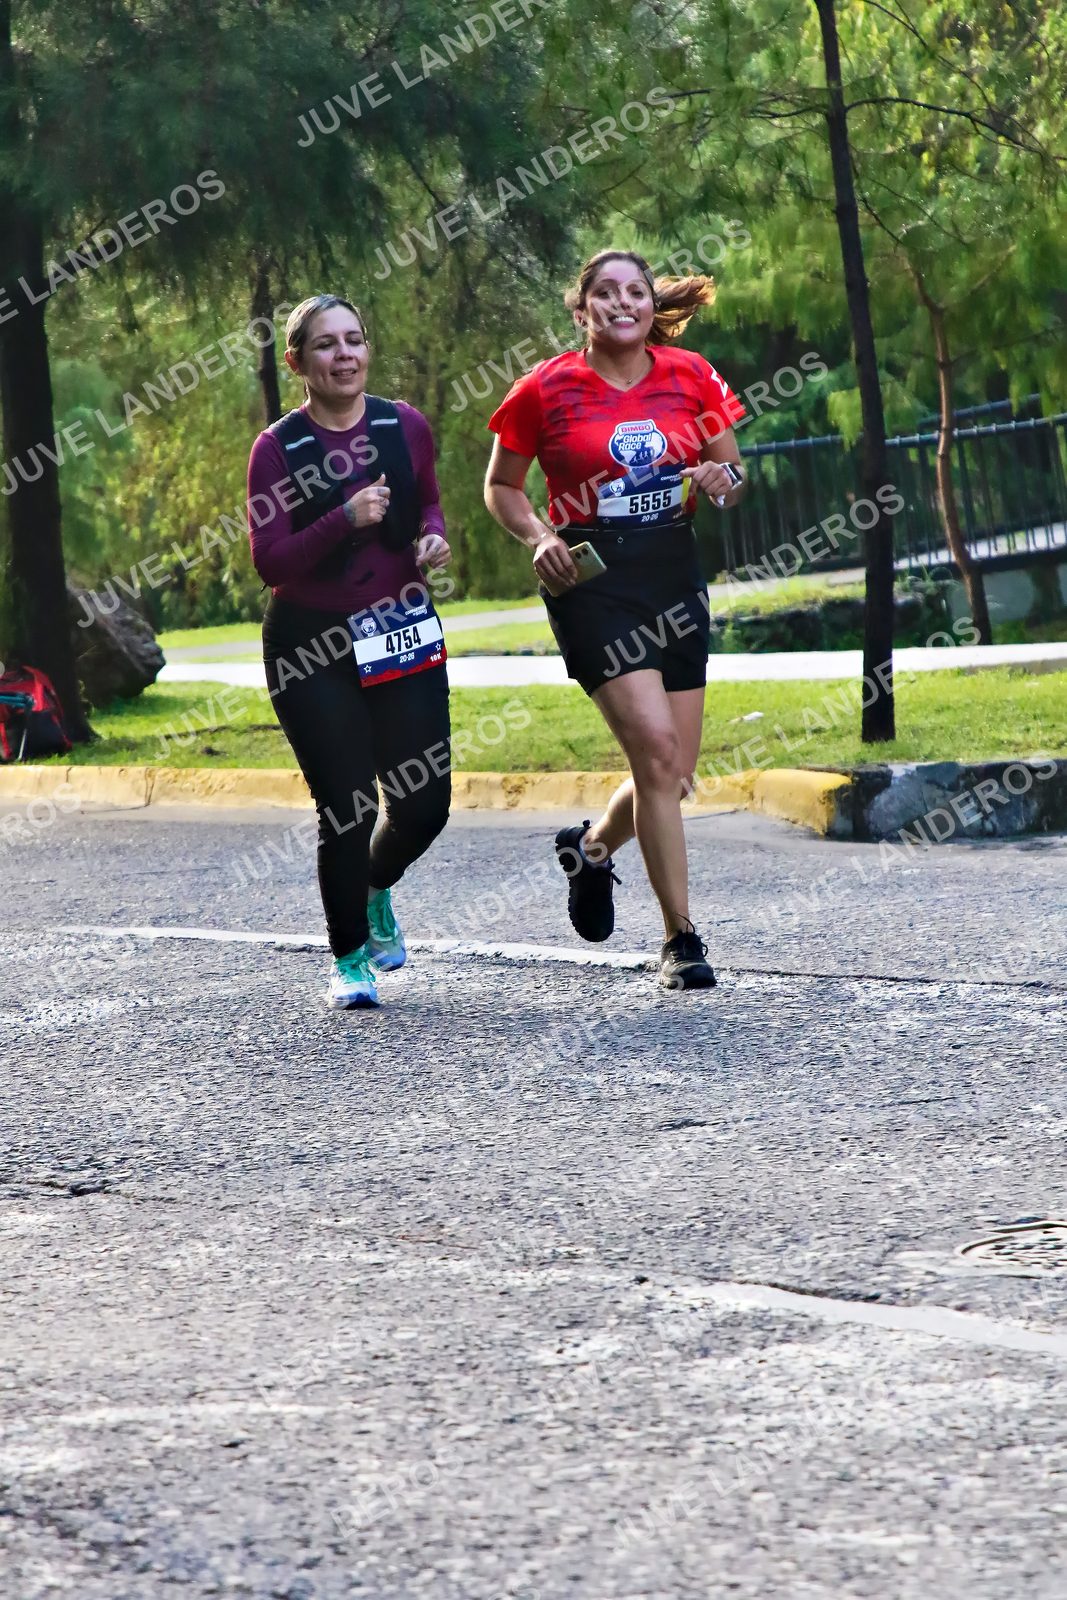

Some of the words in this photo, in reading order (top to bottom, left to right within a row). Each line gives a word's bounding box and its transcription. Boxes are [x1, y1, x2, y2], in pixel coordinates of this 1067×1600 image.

[618, 442, 642, 451] Race
[623, 433, 652, 444] Global
[629, 490, 672, 514] 5555
[385, 625, 422, 654] 4754
